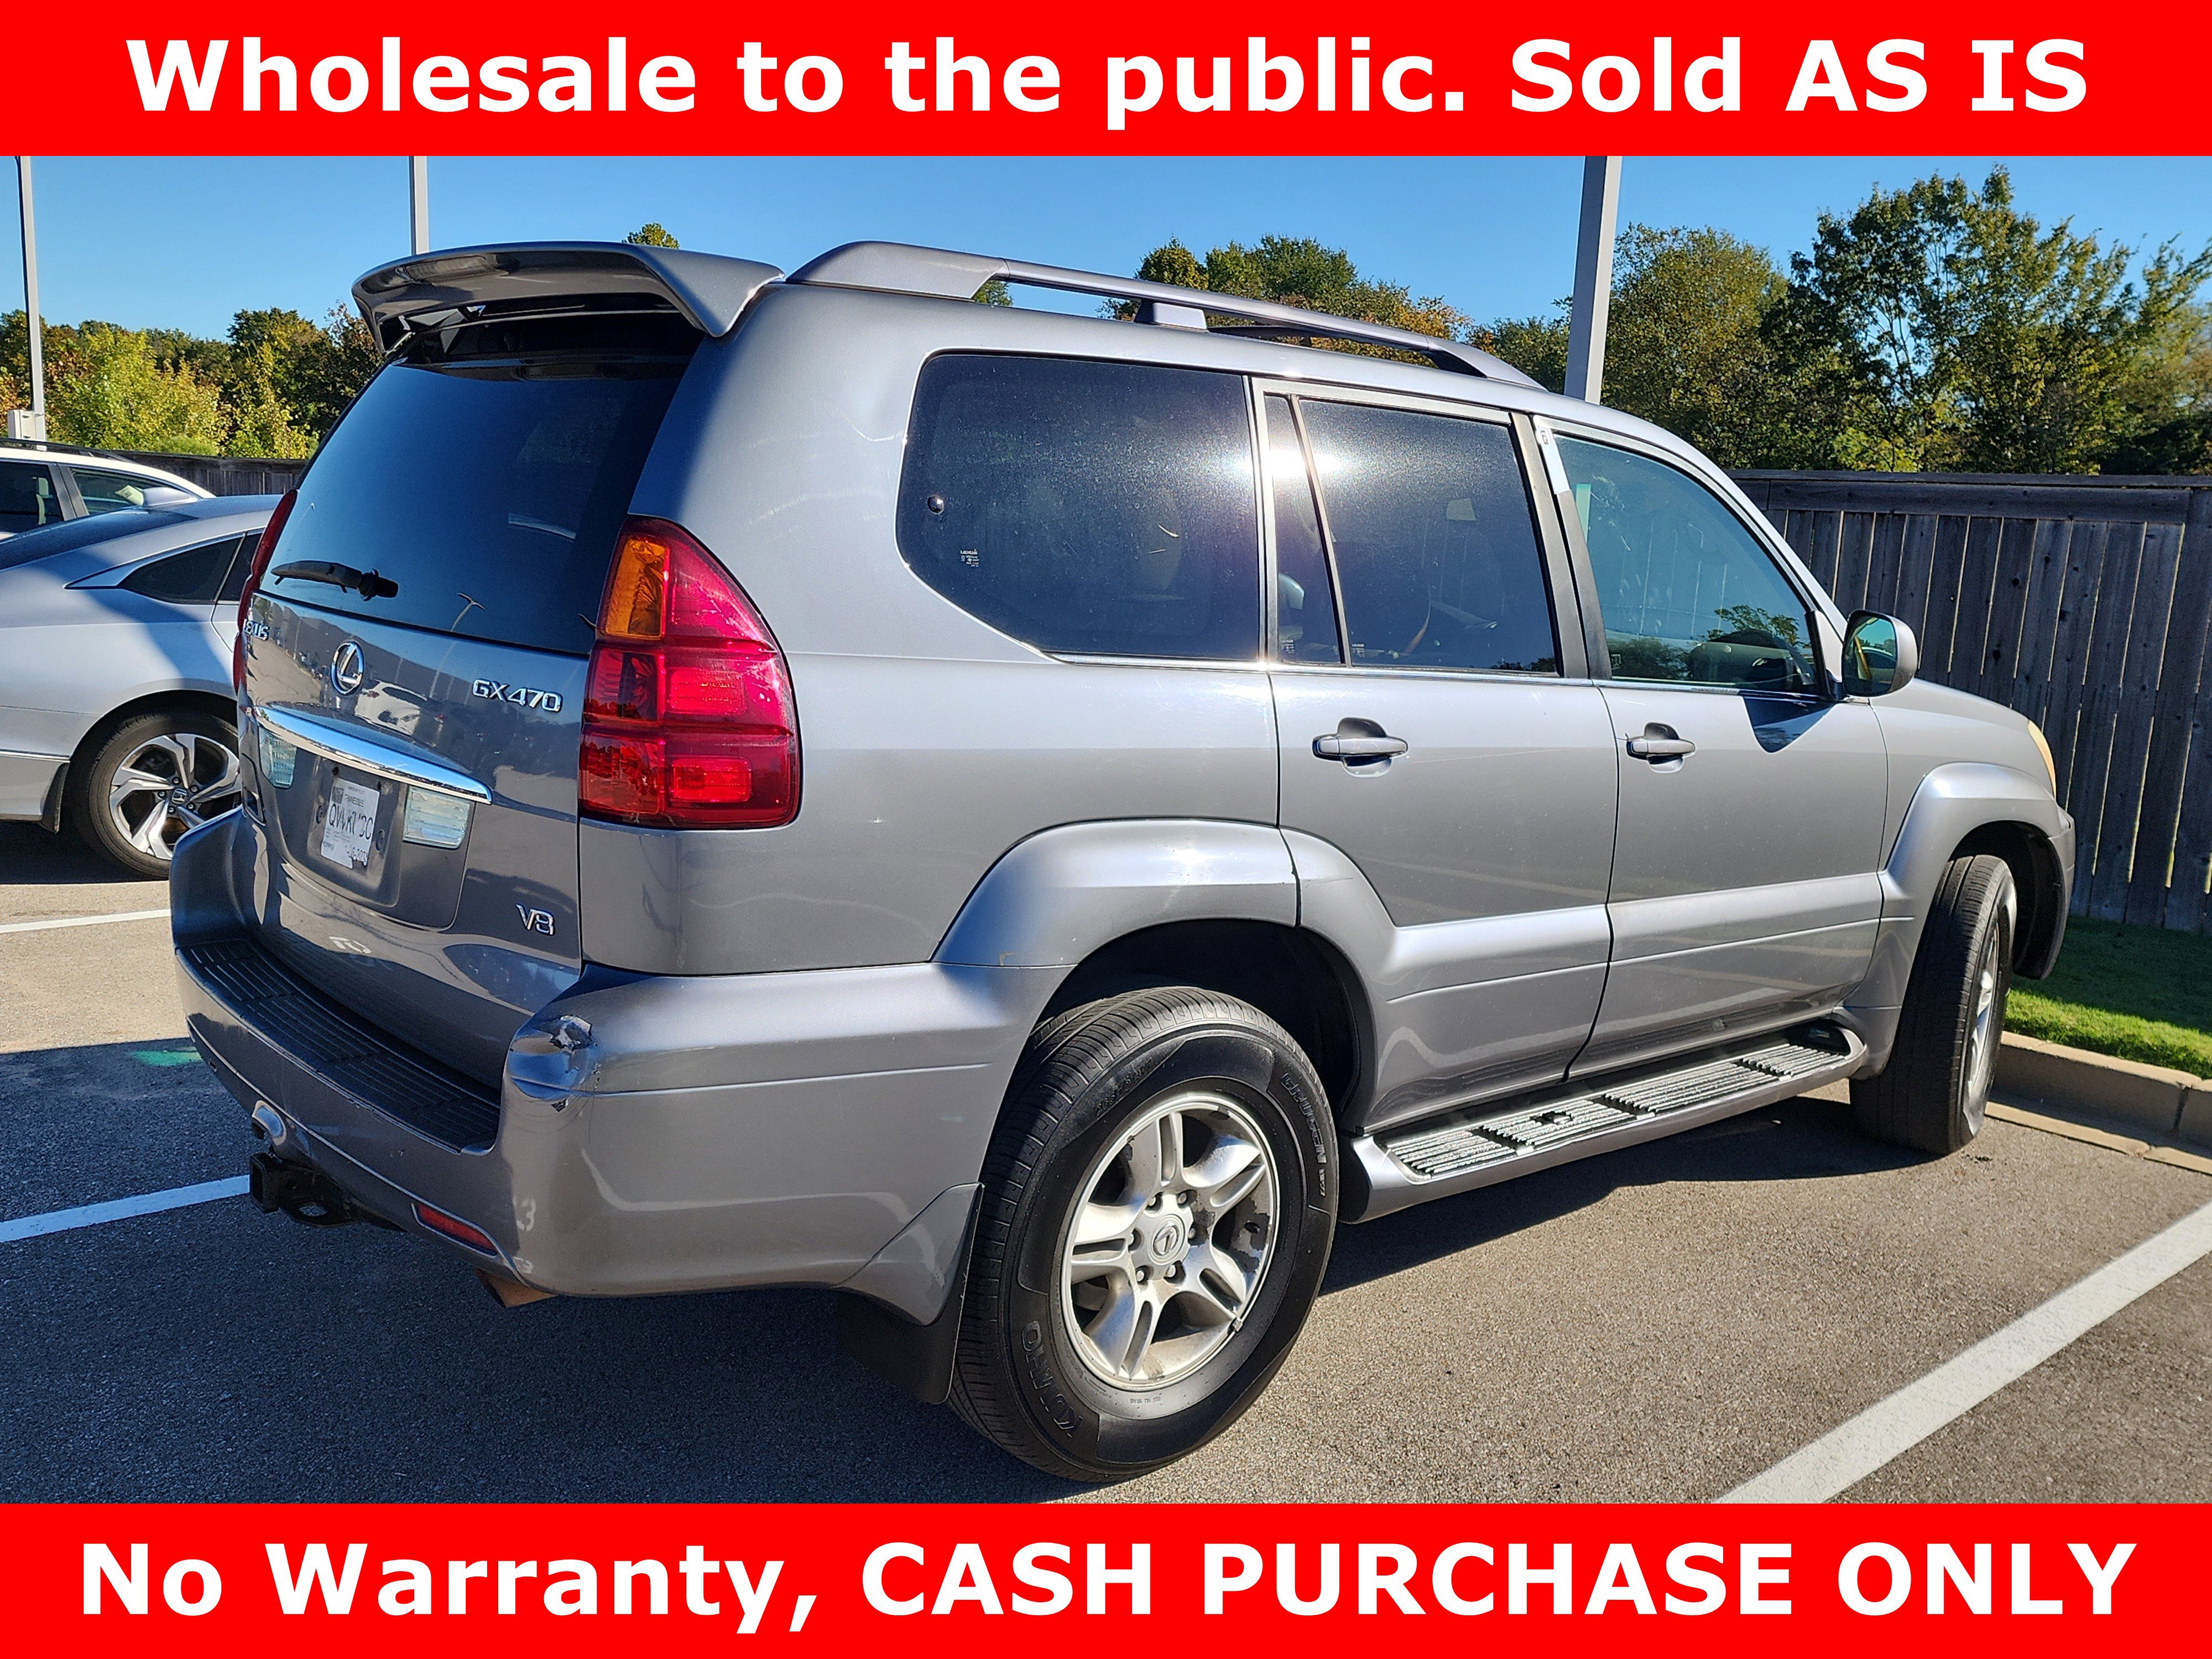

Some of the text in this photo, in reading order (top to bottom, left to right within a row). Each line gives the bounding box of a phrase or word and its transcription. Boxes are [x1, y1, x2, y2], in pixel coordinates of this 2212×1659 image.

[472, 679, 563, 712] GX470
[515, 903, 555, 936] V8
[1022, 1320, 1083, 1438] KUMHO
